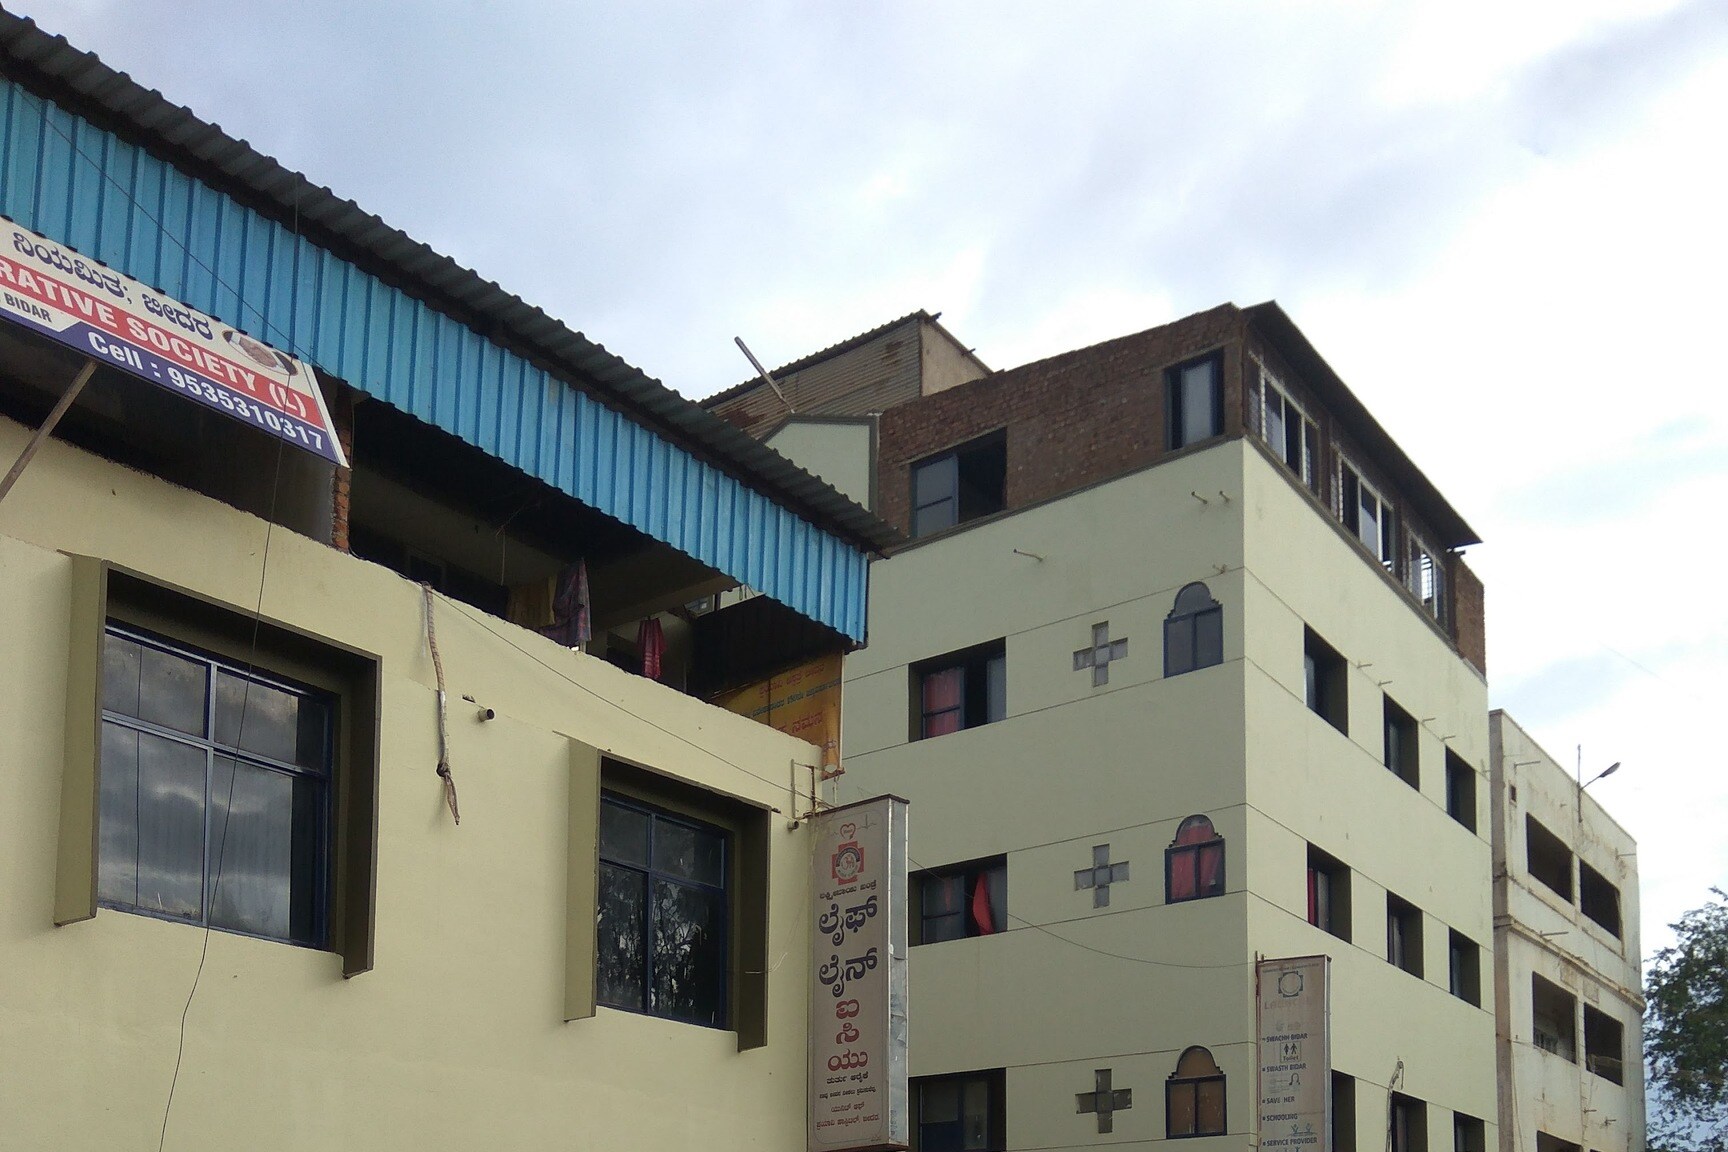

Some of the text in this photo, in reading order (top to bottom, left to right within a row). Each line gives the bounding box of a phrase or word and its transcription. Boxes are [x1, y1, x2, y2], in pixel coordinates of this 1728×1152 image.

[4, 292, 52, 323] BIDAR
[126, 316, 256, 391] SOCIETY
[88, 331, 143, 371] Cell
[168, 367, 323, 450] 9535310317
[818, 895, 878, 947] ಲೈಫ್
[818, 947, 878, 998] ಲೈನ್
[835, 999, 860, 1020] ಐ
[835, 1022, 860, 1045] ಸಿ
[1283, 1095, 1295, 1103] HER
[1266, 1113, 1298, 1122] SCHOOLING
[1266, 1136, 1318, 1146] SERVICE PROVIDER
